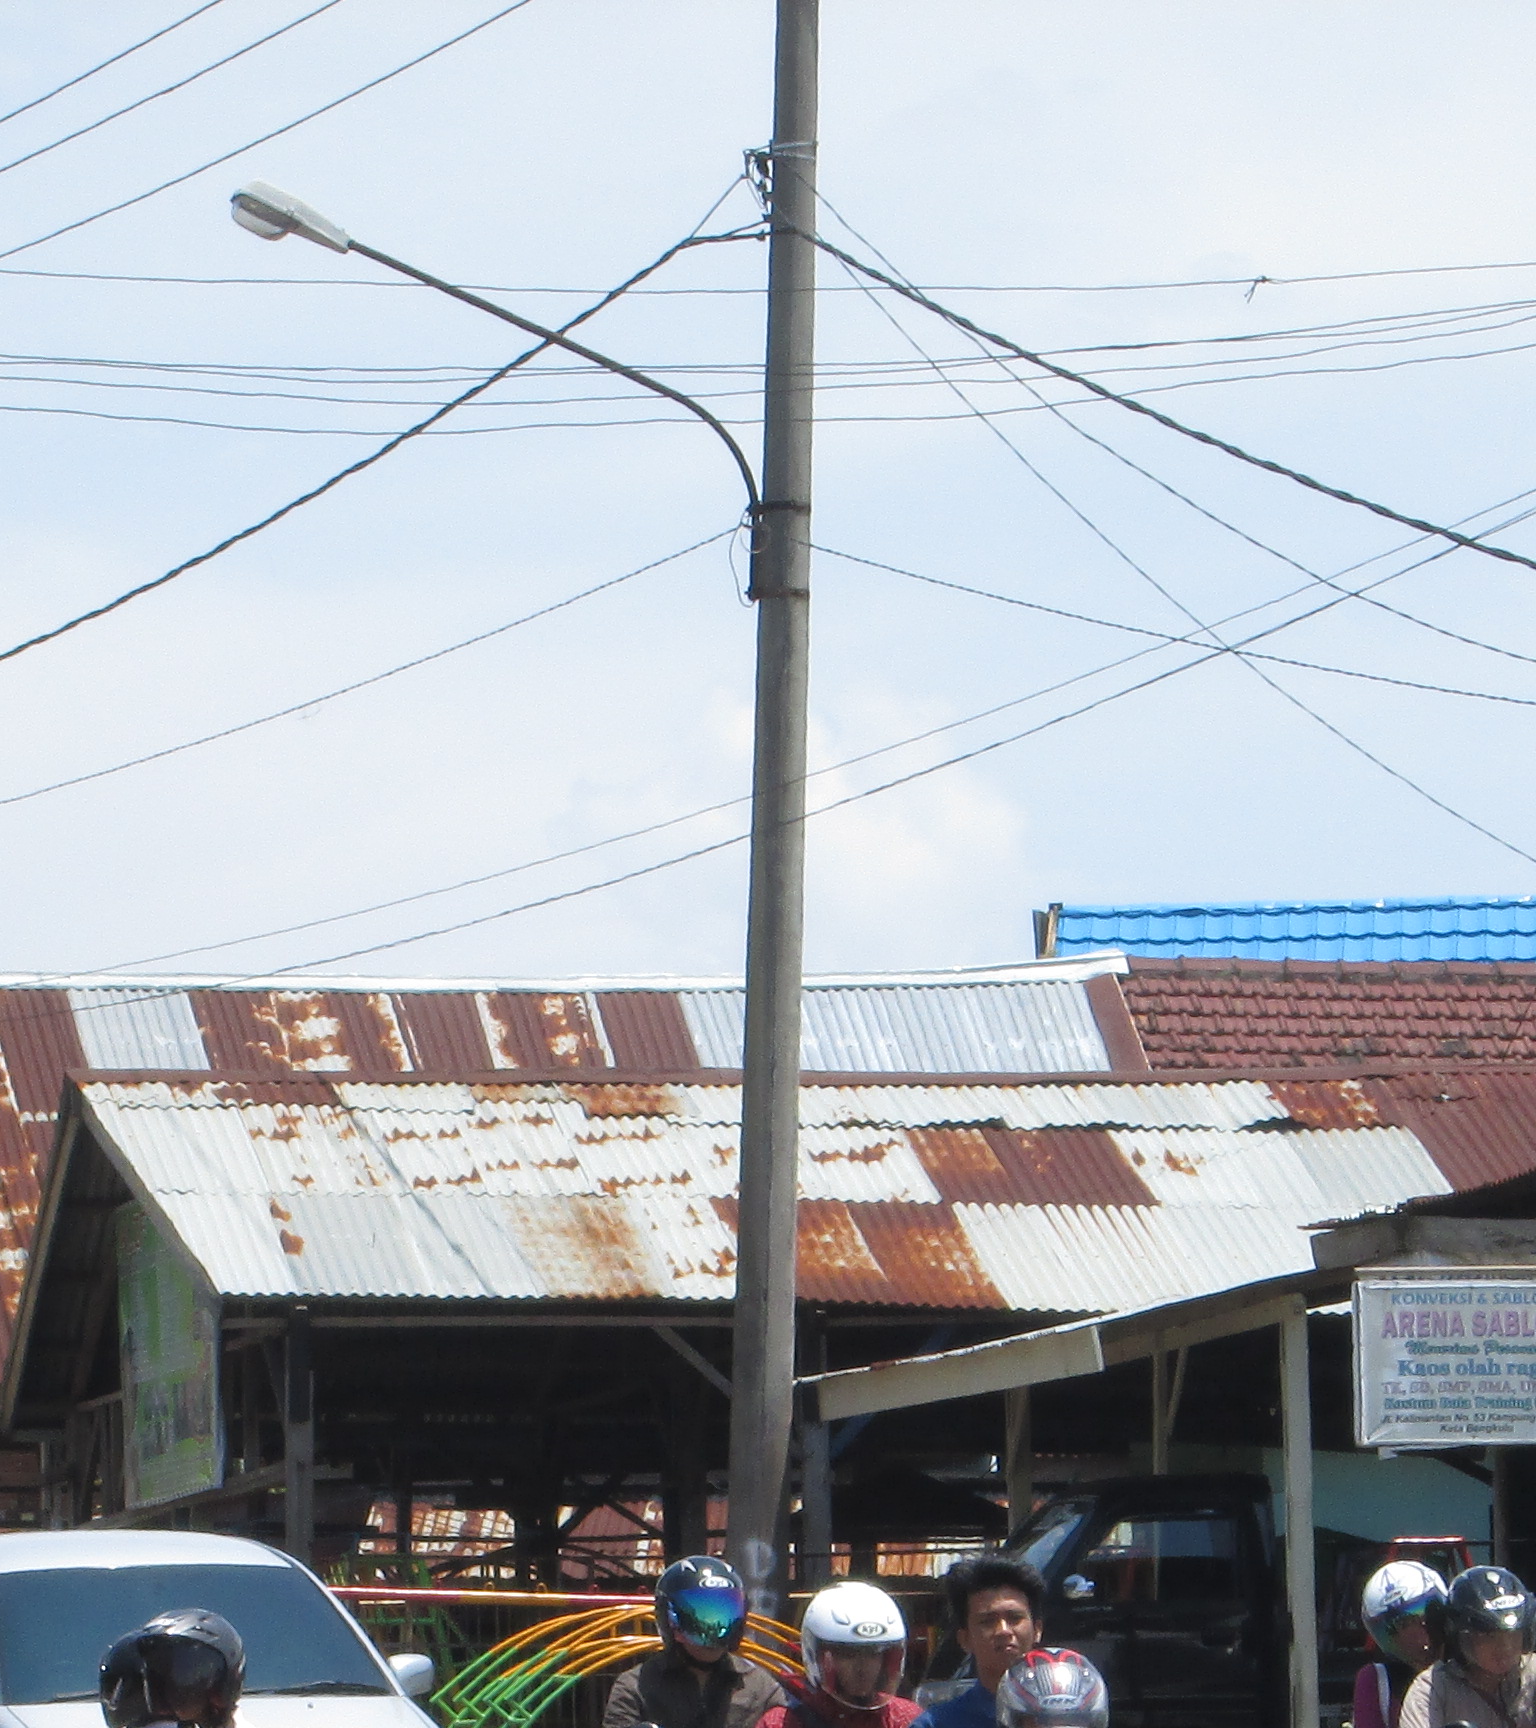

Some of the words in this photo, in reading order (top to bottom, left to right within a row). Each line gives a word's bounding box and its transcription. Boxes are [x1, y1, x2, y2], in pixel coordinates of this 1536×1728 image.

[1390, 1292, 1473, 1306] KONVEKSI
[1477, 1293, 1487, 1305] &
[1381, 1310, 1466, 1339] ARENA
[1396, 1359, 1451, 1377] Kaos
[1456, 1358, 1501, 1376] olah
